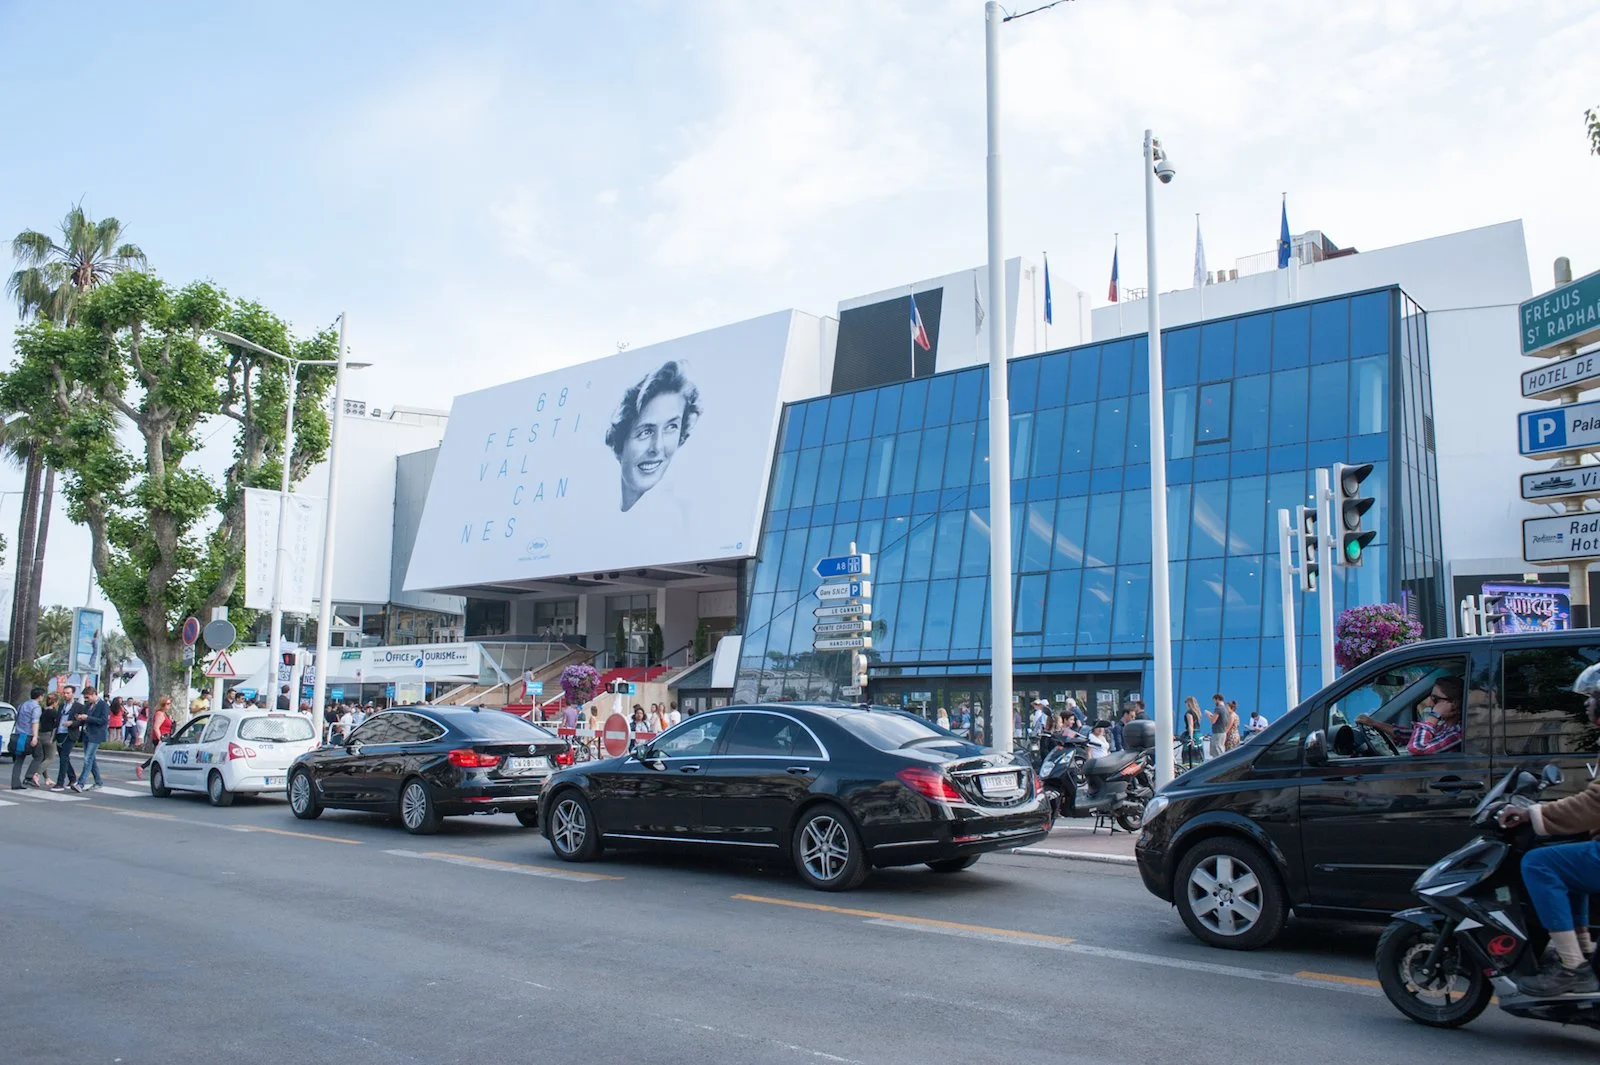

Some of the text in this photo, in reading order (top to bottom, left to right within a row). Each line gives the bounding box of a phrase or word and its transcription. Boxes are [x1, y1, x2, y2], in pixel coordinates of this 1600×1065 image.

[1525, 289, 1580, 325] FRÉJUS
[1529, 359, 1593, 390] HOTEL DE
[485, 413, 581, 452] FESTI
[1538, 418, 1556, 444] P
[479, 454, 529, 482] VAL
[1582, 472, 1600, 486] Vi
[512, 477, 569, 506] CAN
[461, 517, 517, 545] NES
[1570, 519, 1600, 535] Rad
[1571, 535, 1600, 552] Hot
[835, 561, 846, 571] A8
[851, 584, 859, 596] P
[840, 606, 861, 614] CANNET
[829, 639, 862, 647] HANDIPLAGE
[171, 749, 189, 765] OTIS
